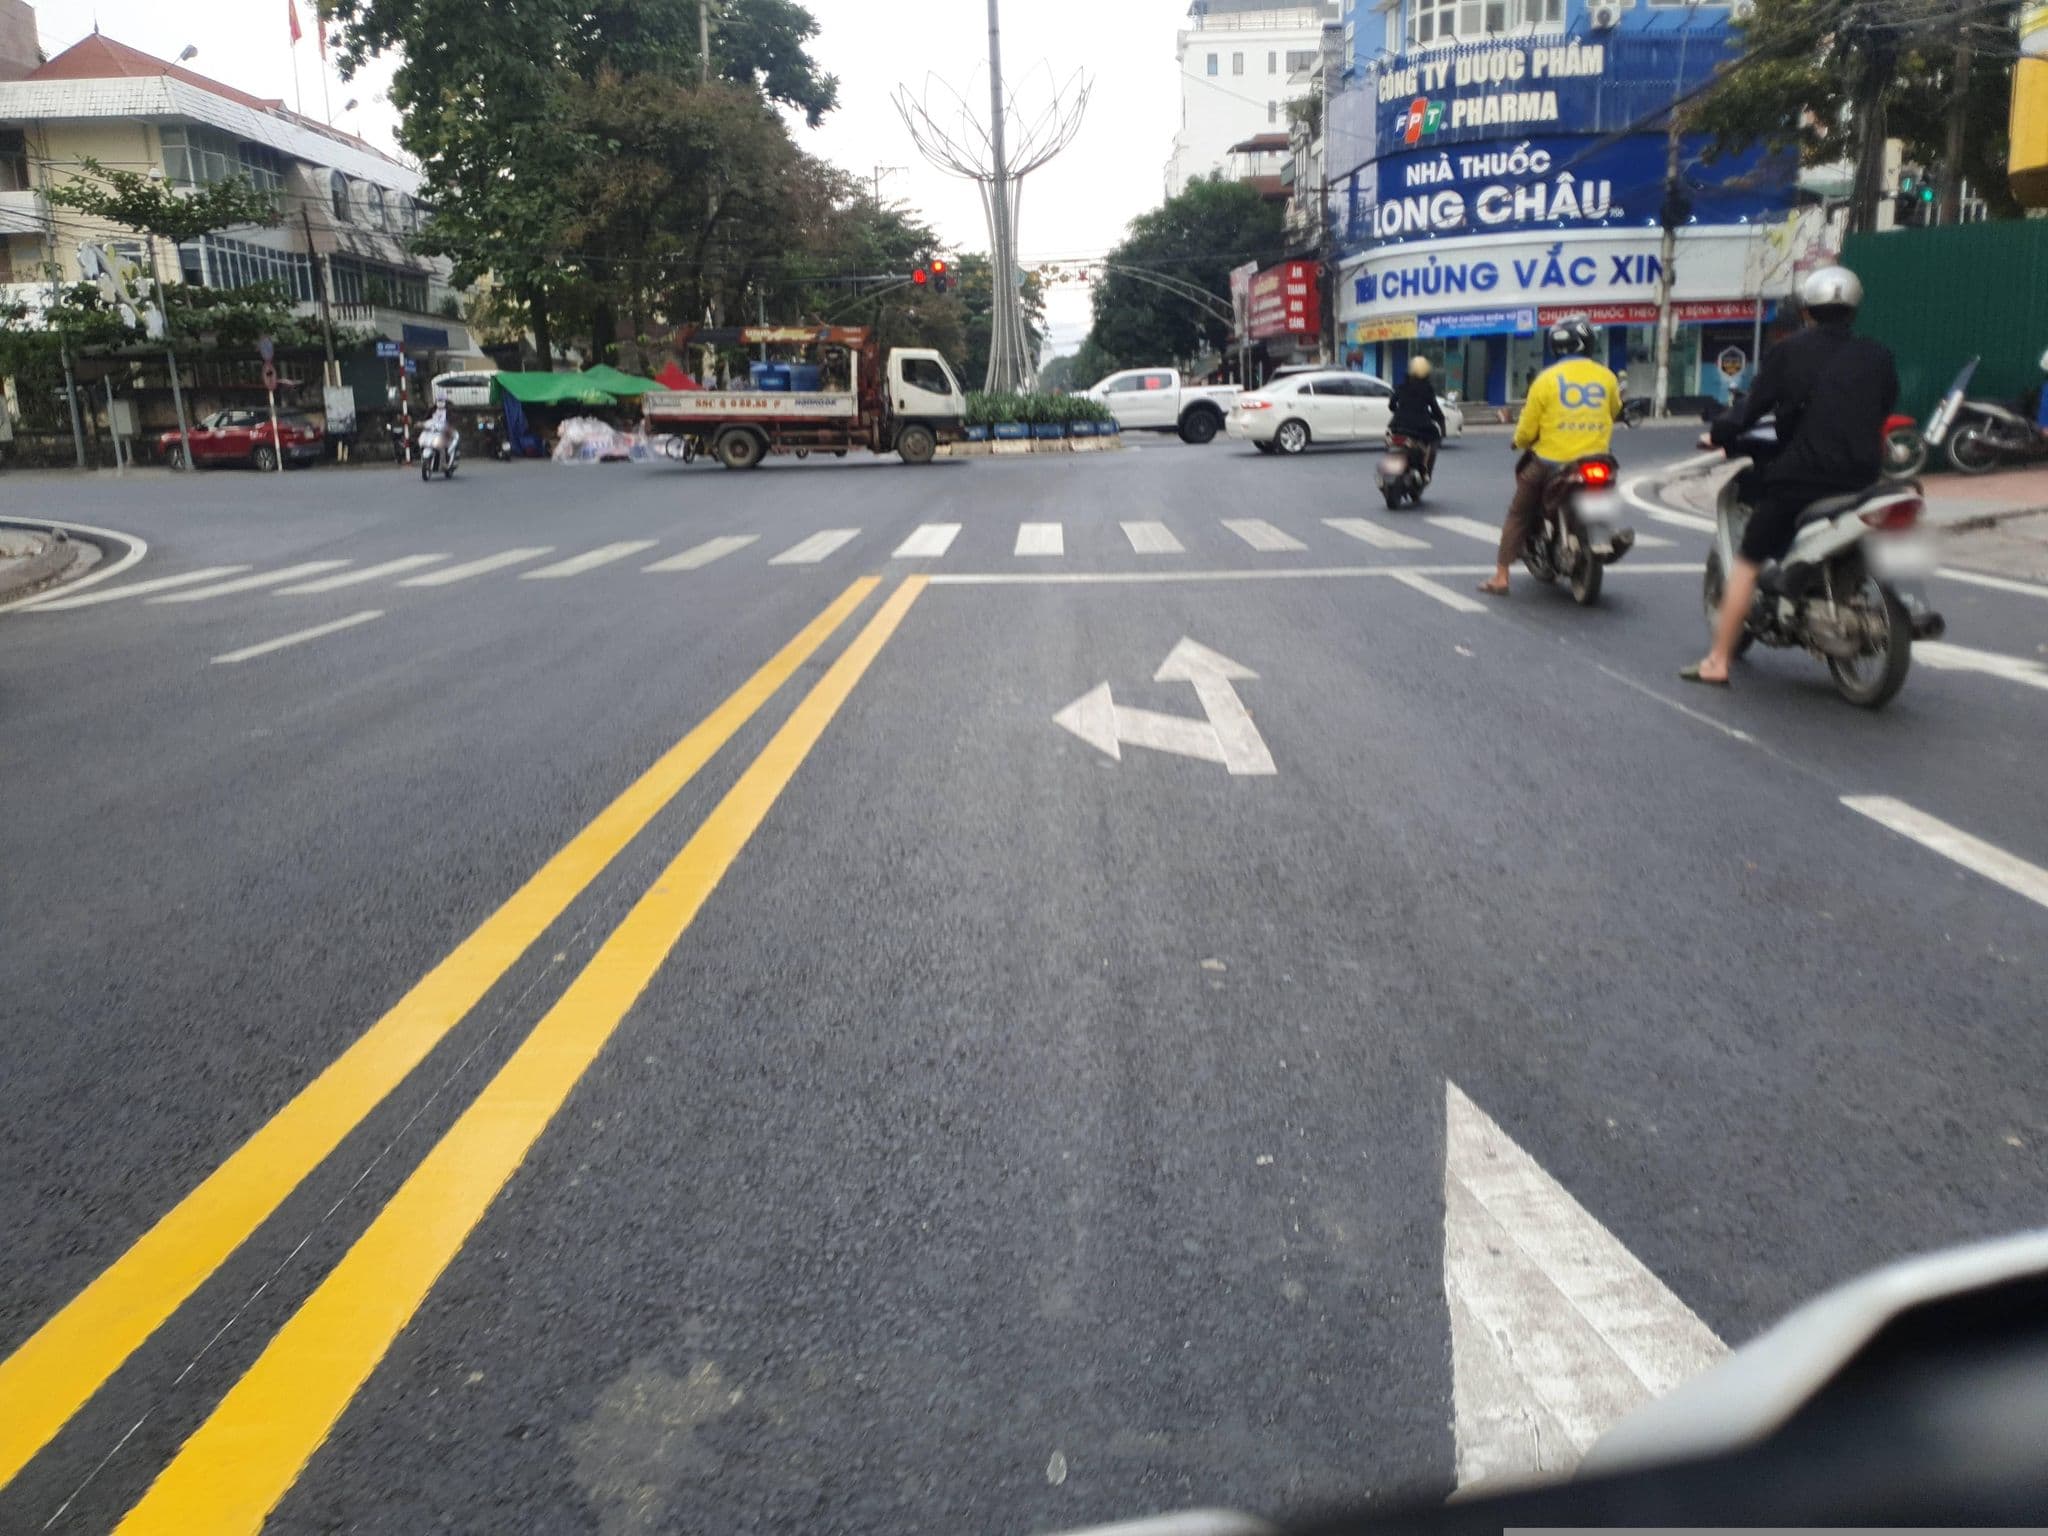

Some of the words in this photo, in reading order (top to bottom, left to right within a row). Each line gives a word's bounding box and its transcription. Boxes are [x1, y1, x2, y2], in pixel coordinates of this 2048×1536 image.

[1379, 66, 1417, 104] CÔNG
[1423, 60, 1448, 91] TY
[1455, 47, 1525, 87] DƯỢC
[1532, 35, 1603, 79] PHẨM
[1395, 105, 1441, 137] FPT
[1451, 91, 1558, 129] PHARMA
[1406, 152, 1454, 187] NHÀ
[1460, 140, 1551, 179] THUỐC
[1373, 190, 1465, 238] LONG
[1477, 171, 1611, 224] CHÂU
[1382, 255, 1498, 299] CHỦNG
[1513, 241, 1597, 288] VẮC
[1609, 254, 1668, 285] XIN
[1558, 374, 1606, 409] be
